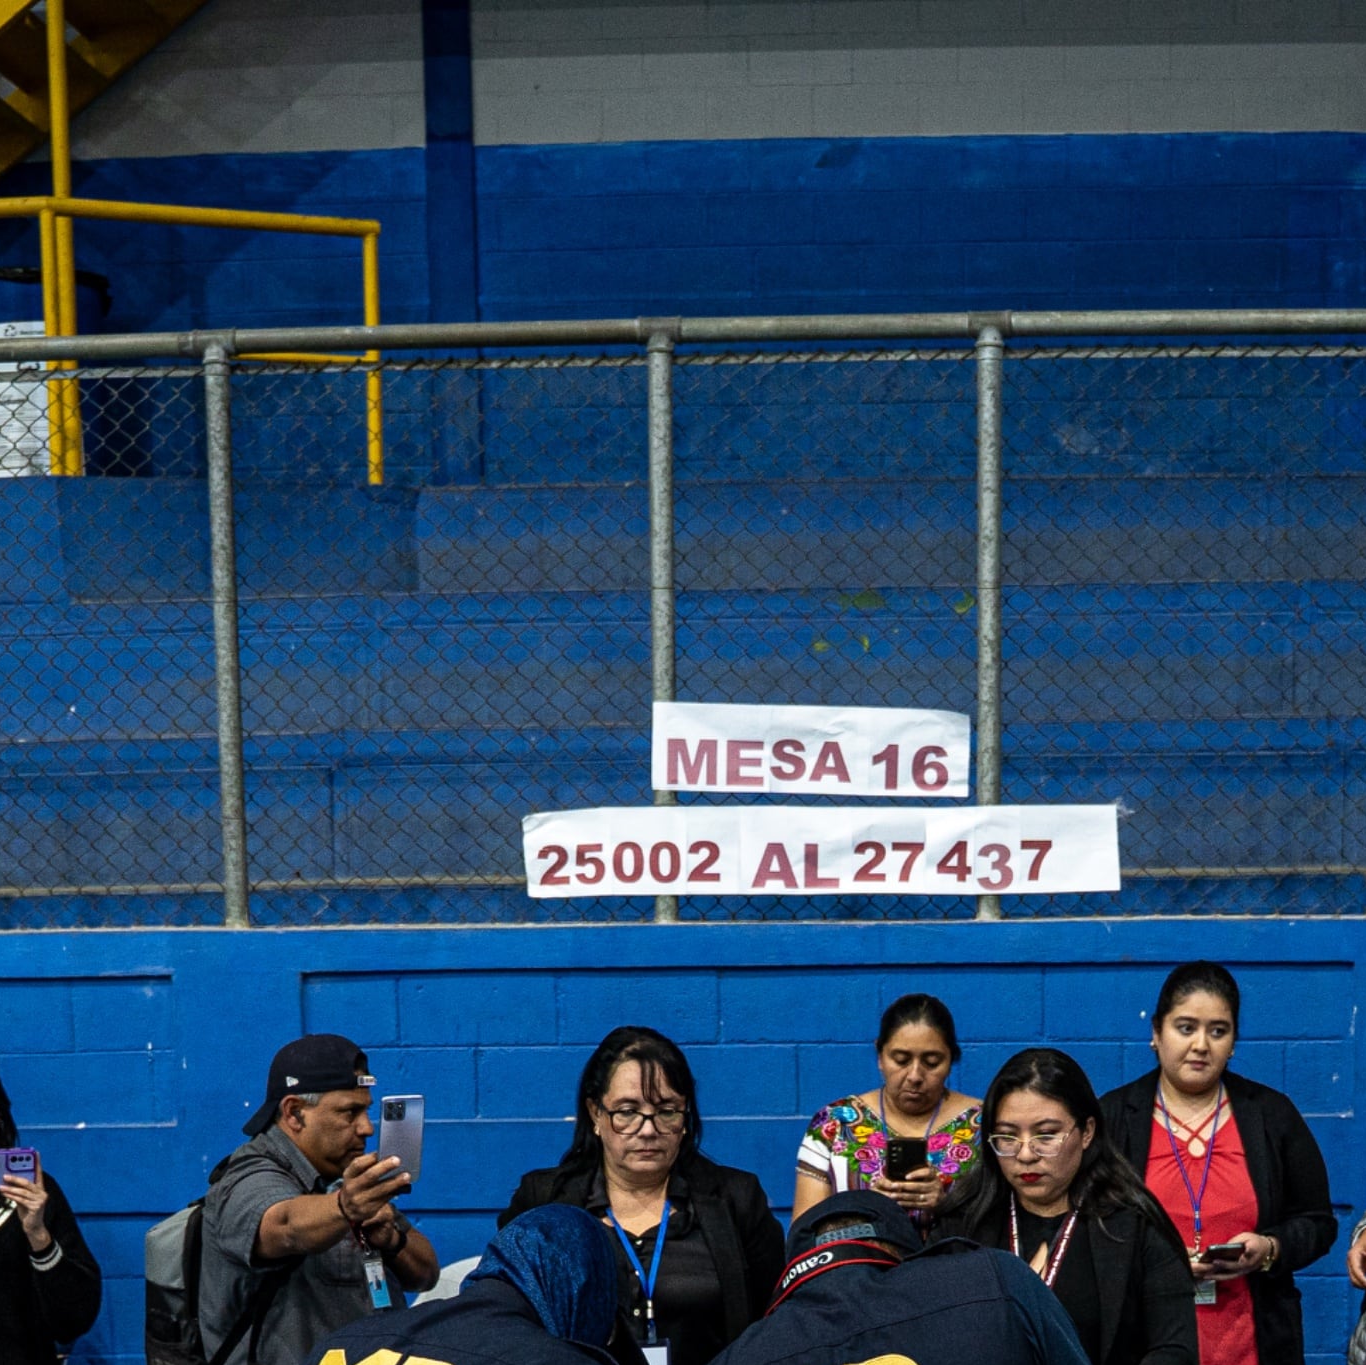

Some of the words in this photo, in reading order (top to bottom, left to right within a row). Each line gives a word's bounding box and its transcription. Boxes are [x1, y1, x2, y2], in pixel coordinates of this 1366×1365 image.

[666, 738, 851, 784] MESA
[871, 744, 949, 791] 16
[537, 841, 721, 885] 25002
[751, 843, 840, 888] AL
[853, 840, 1053, 891] 27437
[782, 1251, 834, 1289] Canon
